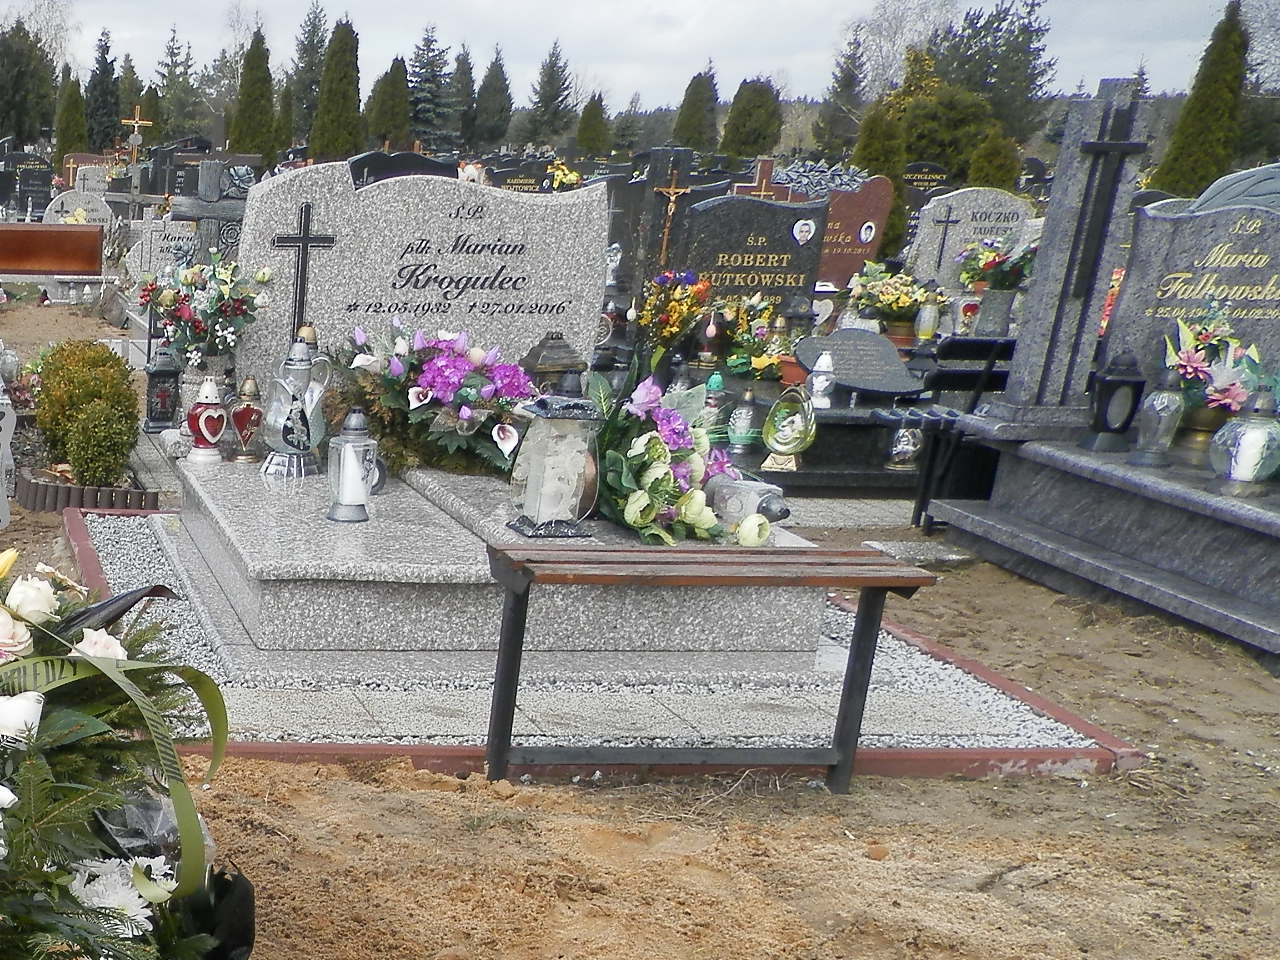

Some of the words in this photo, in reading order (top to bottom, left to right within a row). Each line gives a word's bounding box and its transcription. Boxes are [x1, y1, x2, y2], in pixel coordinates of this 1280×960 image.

[437, 233, 527, 255] Marian
[747, 233, 767, 246] Ś.P.
[716, 254, 791, 266] ROBERT
[1194, 242, 1271, 267] Maria
[392, 263, 527, 301] Krogulec
[364, 302, 452, 317] 12.05.1932
[481, 301, 571, 315] 27.01.2016
